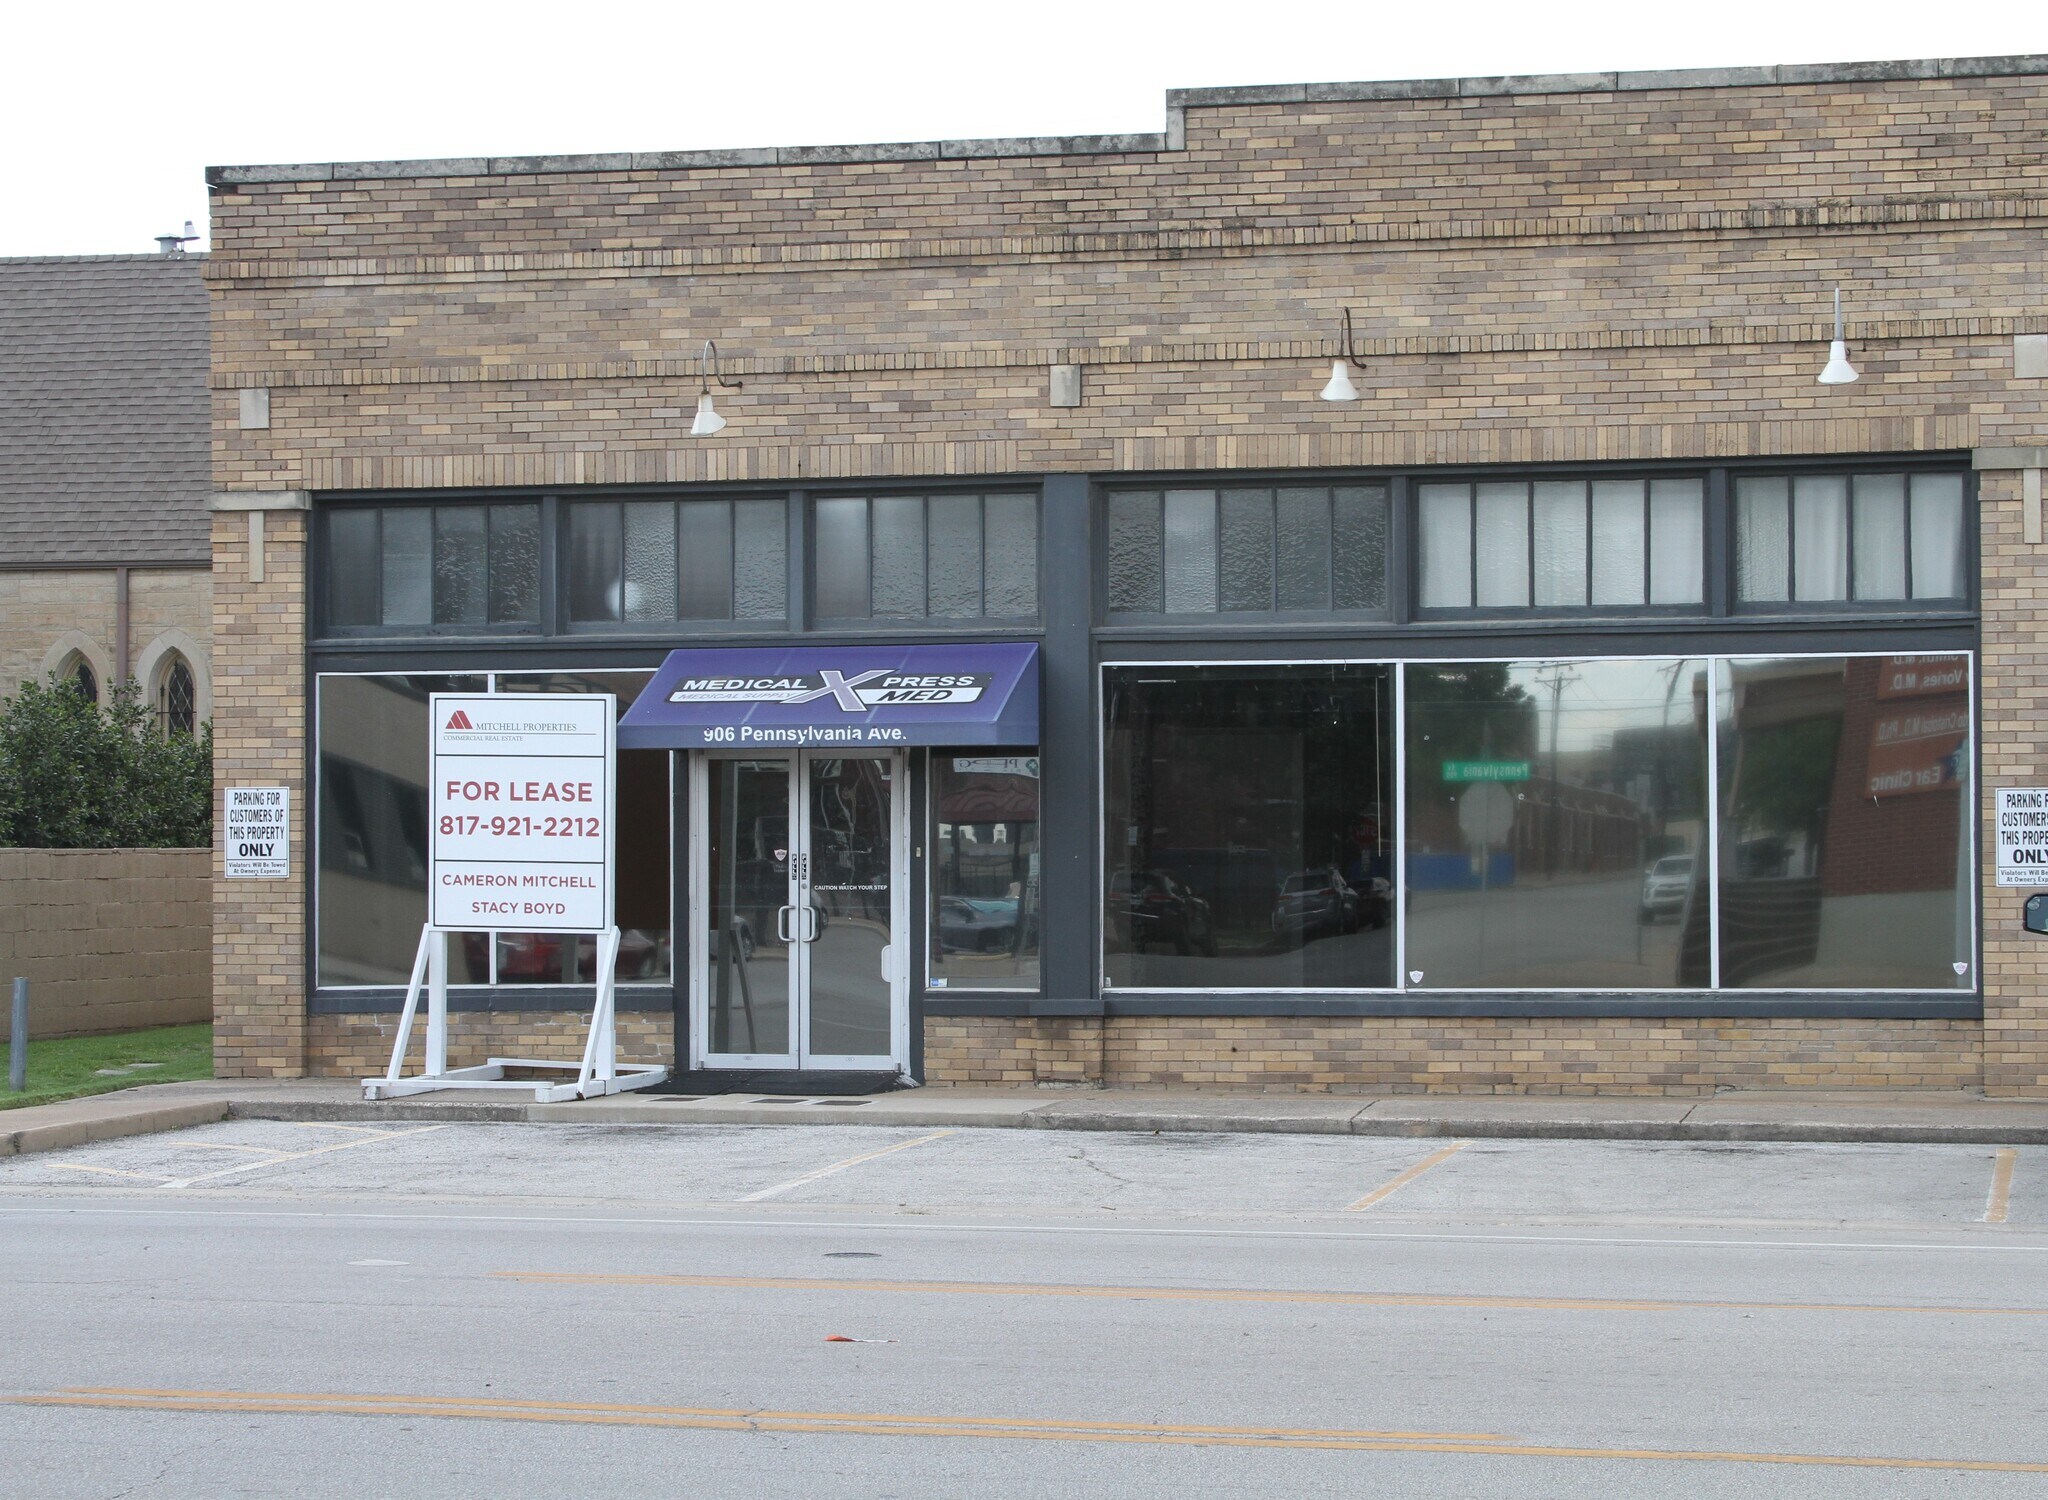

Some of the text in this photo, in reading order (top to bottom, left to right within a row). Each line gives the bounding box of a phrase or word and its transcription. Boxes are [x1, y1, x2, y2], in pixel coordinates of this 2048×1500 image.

[682, 678, 808, 691] MEDICAL
[882, 675, 975, 687] PRESS
[742, 691, 797, 699] SUPPLY
[876, 689, 952, 702] MED
[476, 722, 577, 731] MITCHELL PROPERTIES
[703, 726, 907, 744] 906 Pennsylvania Ave.
[233, 792, 281, 805] PARKING FOR
[446, 781, 593, 802] FOR LEASE
[2006, 793, 2042, 808] PARKING
[229, 809, 284, 823] CUSTOMERS OF
[229, 826, 285, 840] THIS PROPERTY
[439, 815, 600, 837] 817-921-2212
[2001, 830, 2048, 845] THIS PROPE
[238, 843, 275, 857] ONLY
[442, 874, 597, 888] CAMERON MITCHELL
[471, 902, 566, 915] STACY BOYD
